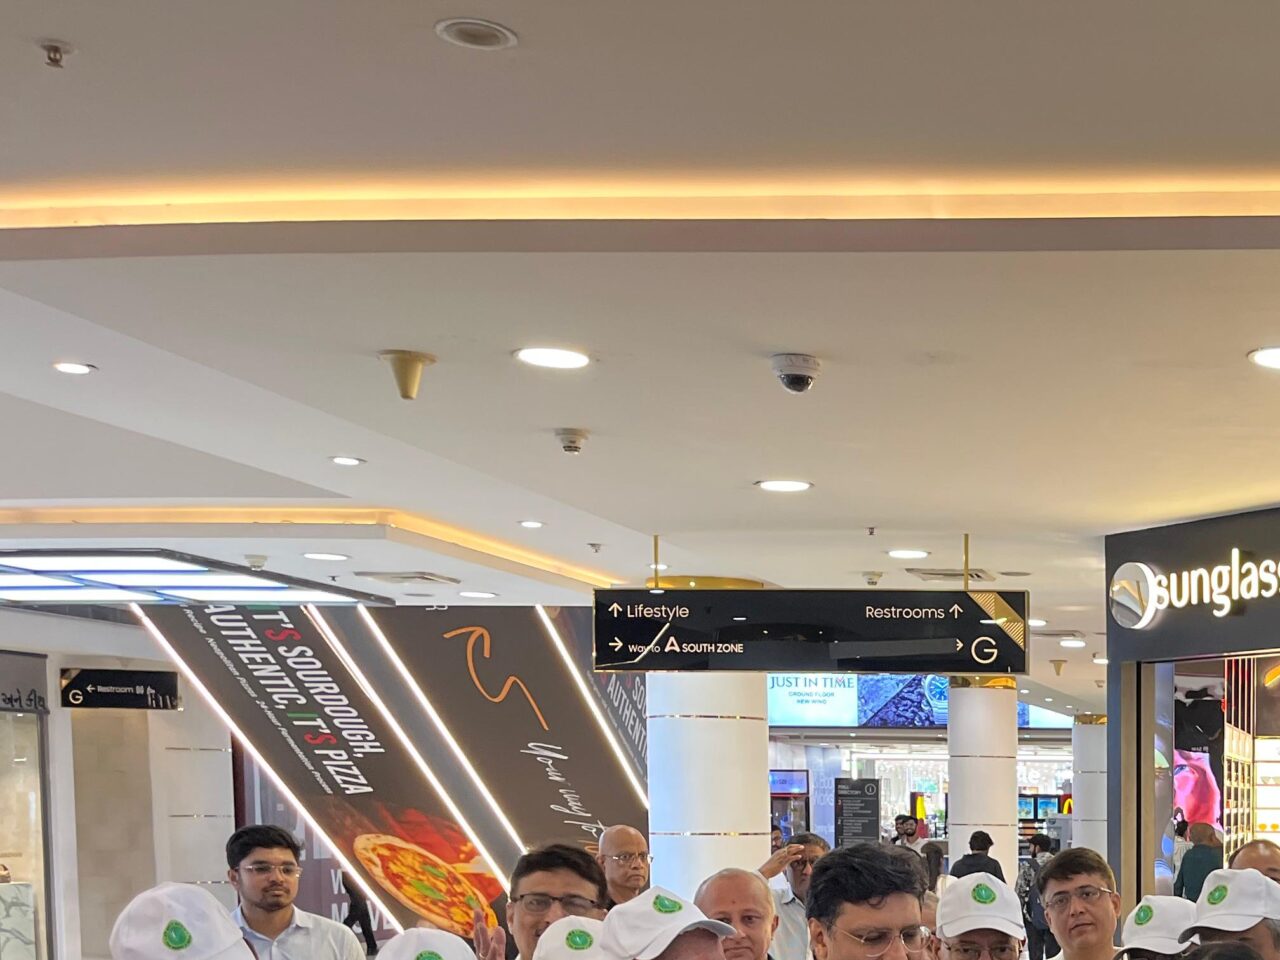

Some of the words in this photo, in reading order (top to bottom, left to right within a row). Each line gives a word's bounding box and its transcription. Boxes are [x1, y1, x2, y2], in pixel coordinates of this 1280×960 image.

[627, 604, 689, 621] Lifestyle
[865, 605, 945, 619] Restrooms
[682, 643, 715, 653] SOUTH
[717, 643, 744, 653] ZONE
[971, 636, 998, 664] G
[770, 676, 800, 689] JUST
[804, 677, 818, 688] IN
[822, 676, 854, 689] TIME
[69, 689, 83, 704] G
[278, 645, 386, 758] SOURDOUGH,
[287, 711, 337, 746] IT'S
[313, 749, 374, 795] PIZZA
[550, 787, 592, 817] way
